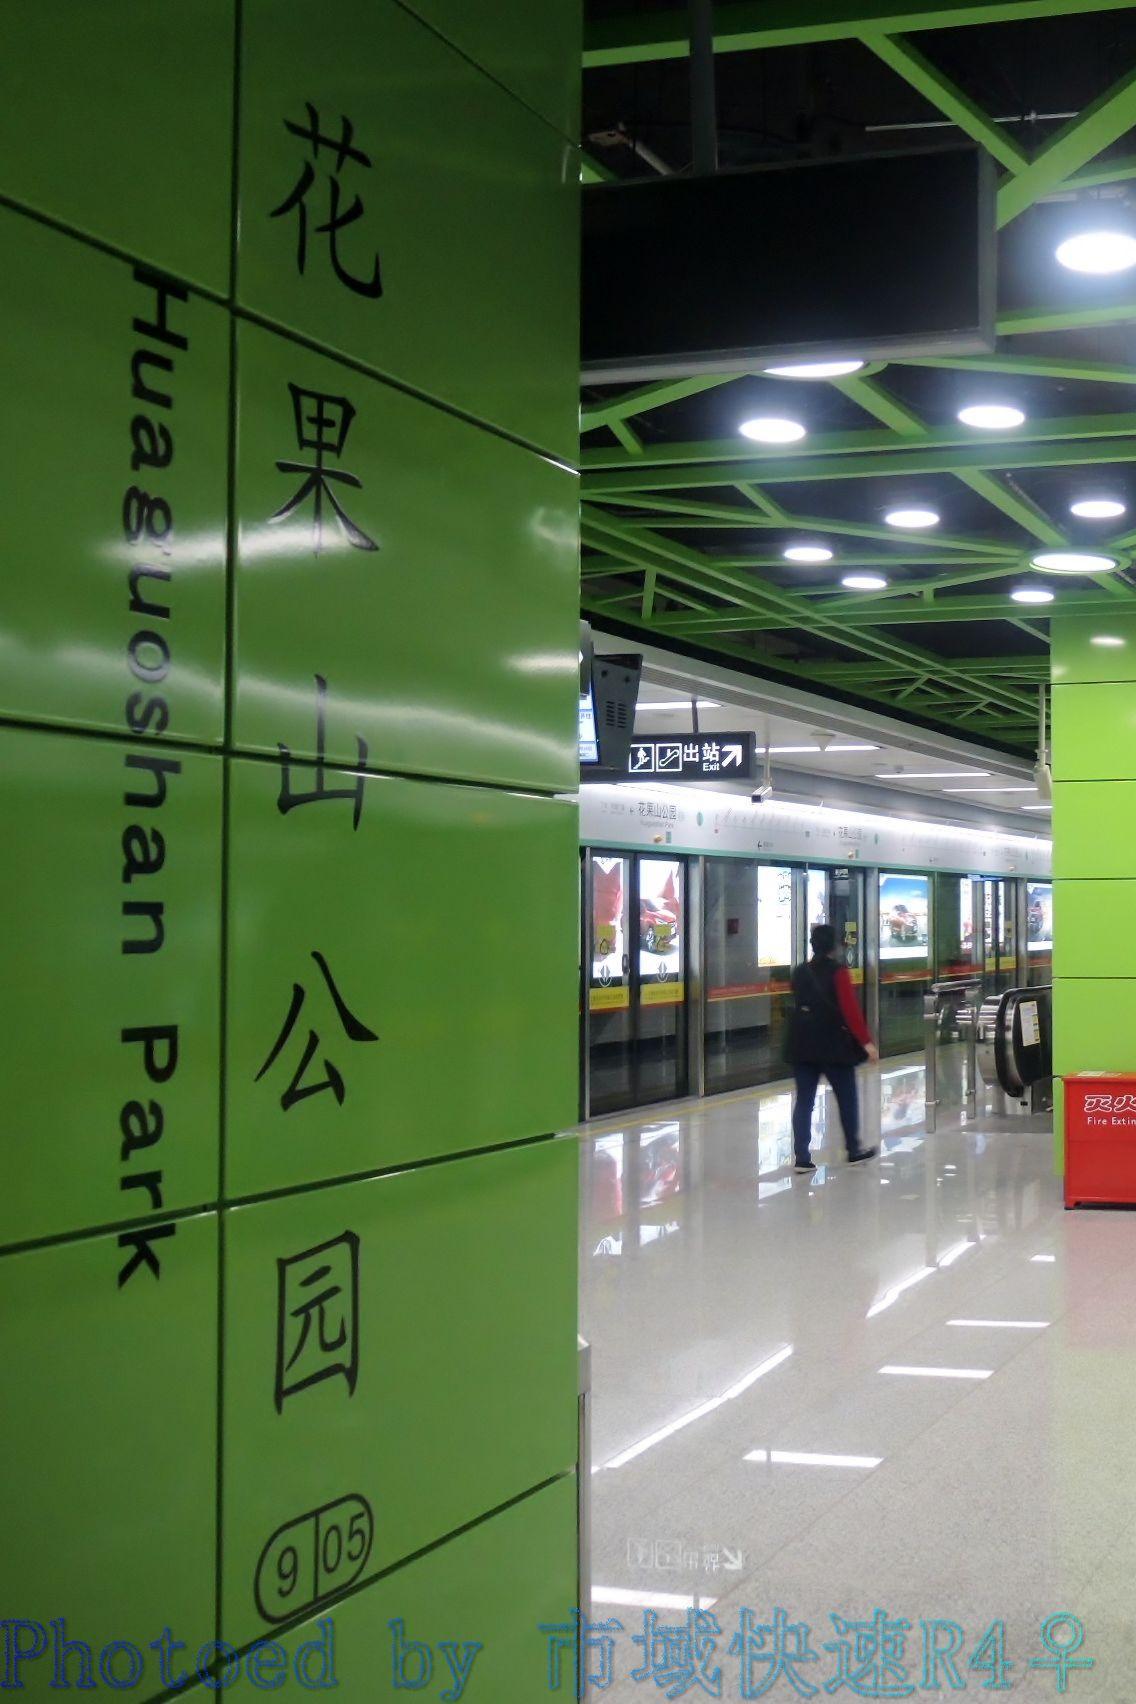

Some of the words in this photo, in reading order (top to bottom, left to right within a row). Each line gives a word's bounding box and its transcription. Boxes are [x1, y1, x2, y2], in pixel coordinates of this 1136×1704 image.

[121, 262, 190, 956] Huaguoshan
[255, 102, 383, 1415] 花果山公园
[683, 742, 720, 763] 出站
[702, 762, 720, 771] Exit
[116, 1024, 179, 1290] Park
[1087, 1116, 1107, 1126] Fire
[277, 1545, 299, 1598] 9
[322, 1511, 366, 1574] 05
